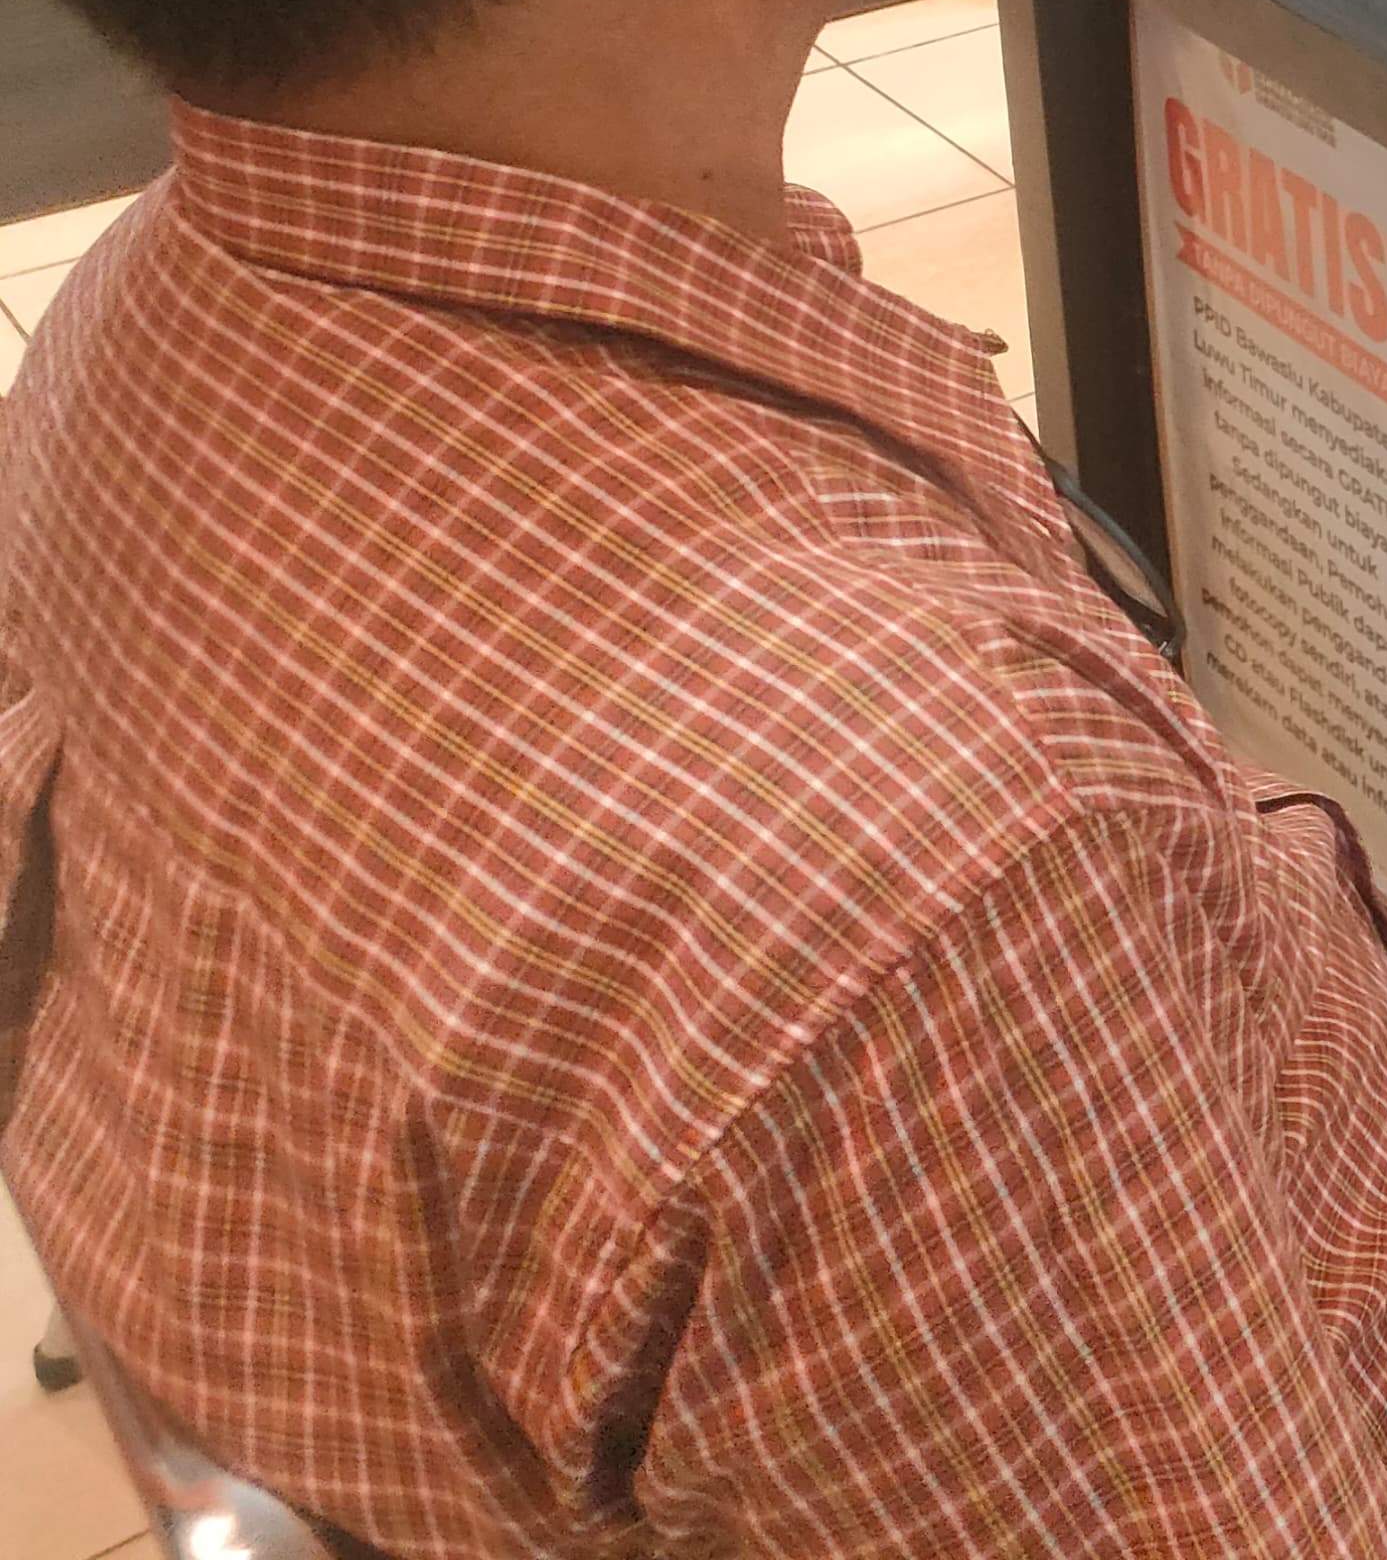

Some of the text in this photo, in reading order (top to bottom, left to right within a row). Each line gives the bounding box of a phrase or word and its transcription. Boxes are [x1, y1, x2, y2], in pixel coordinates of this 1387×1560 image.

[1193, 295, 1233, 338] PPID
[1235, 326, 1304, 391] Bawaslu
[1193, 329, 1236, 376] Luwu
[1240, 362, 1287, 413] Timur
[1231, 454, 1380, 580] Sedangkan untuk
[1264, 448, 1341, 519] dipungut
[1297, 568, 1351, 624] Publik
